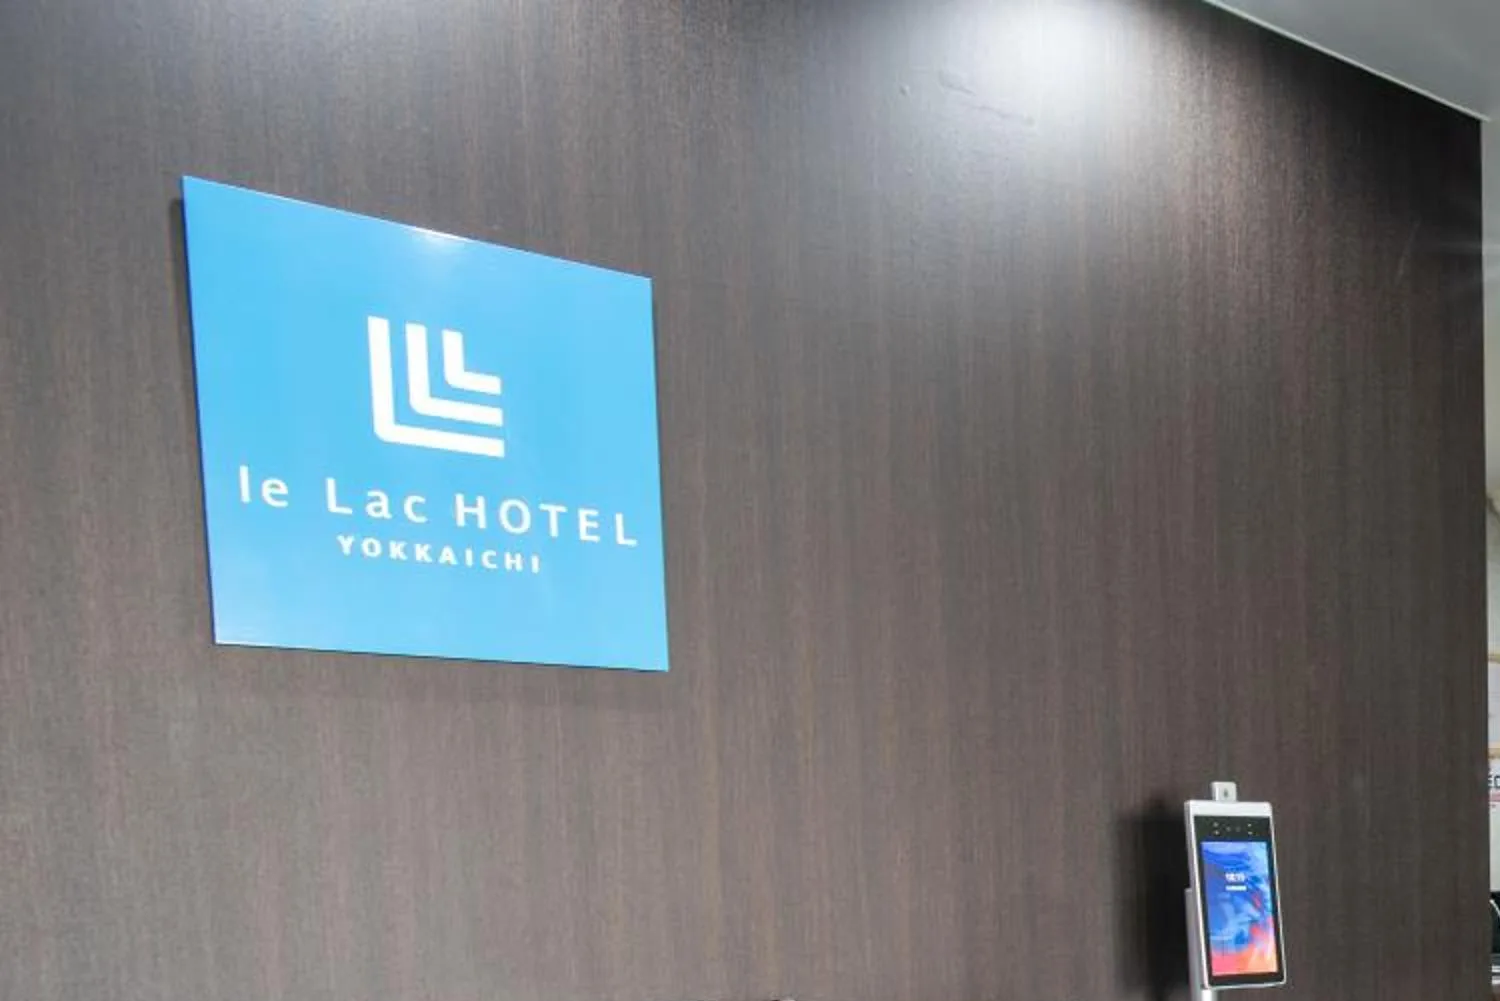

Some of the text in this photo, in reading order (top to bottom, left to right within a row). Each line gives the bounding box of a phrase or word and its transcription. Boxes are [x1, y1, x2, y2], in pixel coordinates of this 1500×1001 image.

[239, 465, 638, 546] le Lac HOTEL
[337, 534, 541, 573] YOKKAICHI
